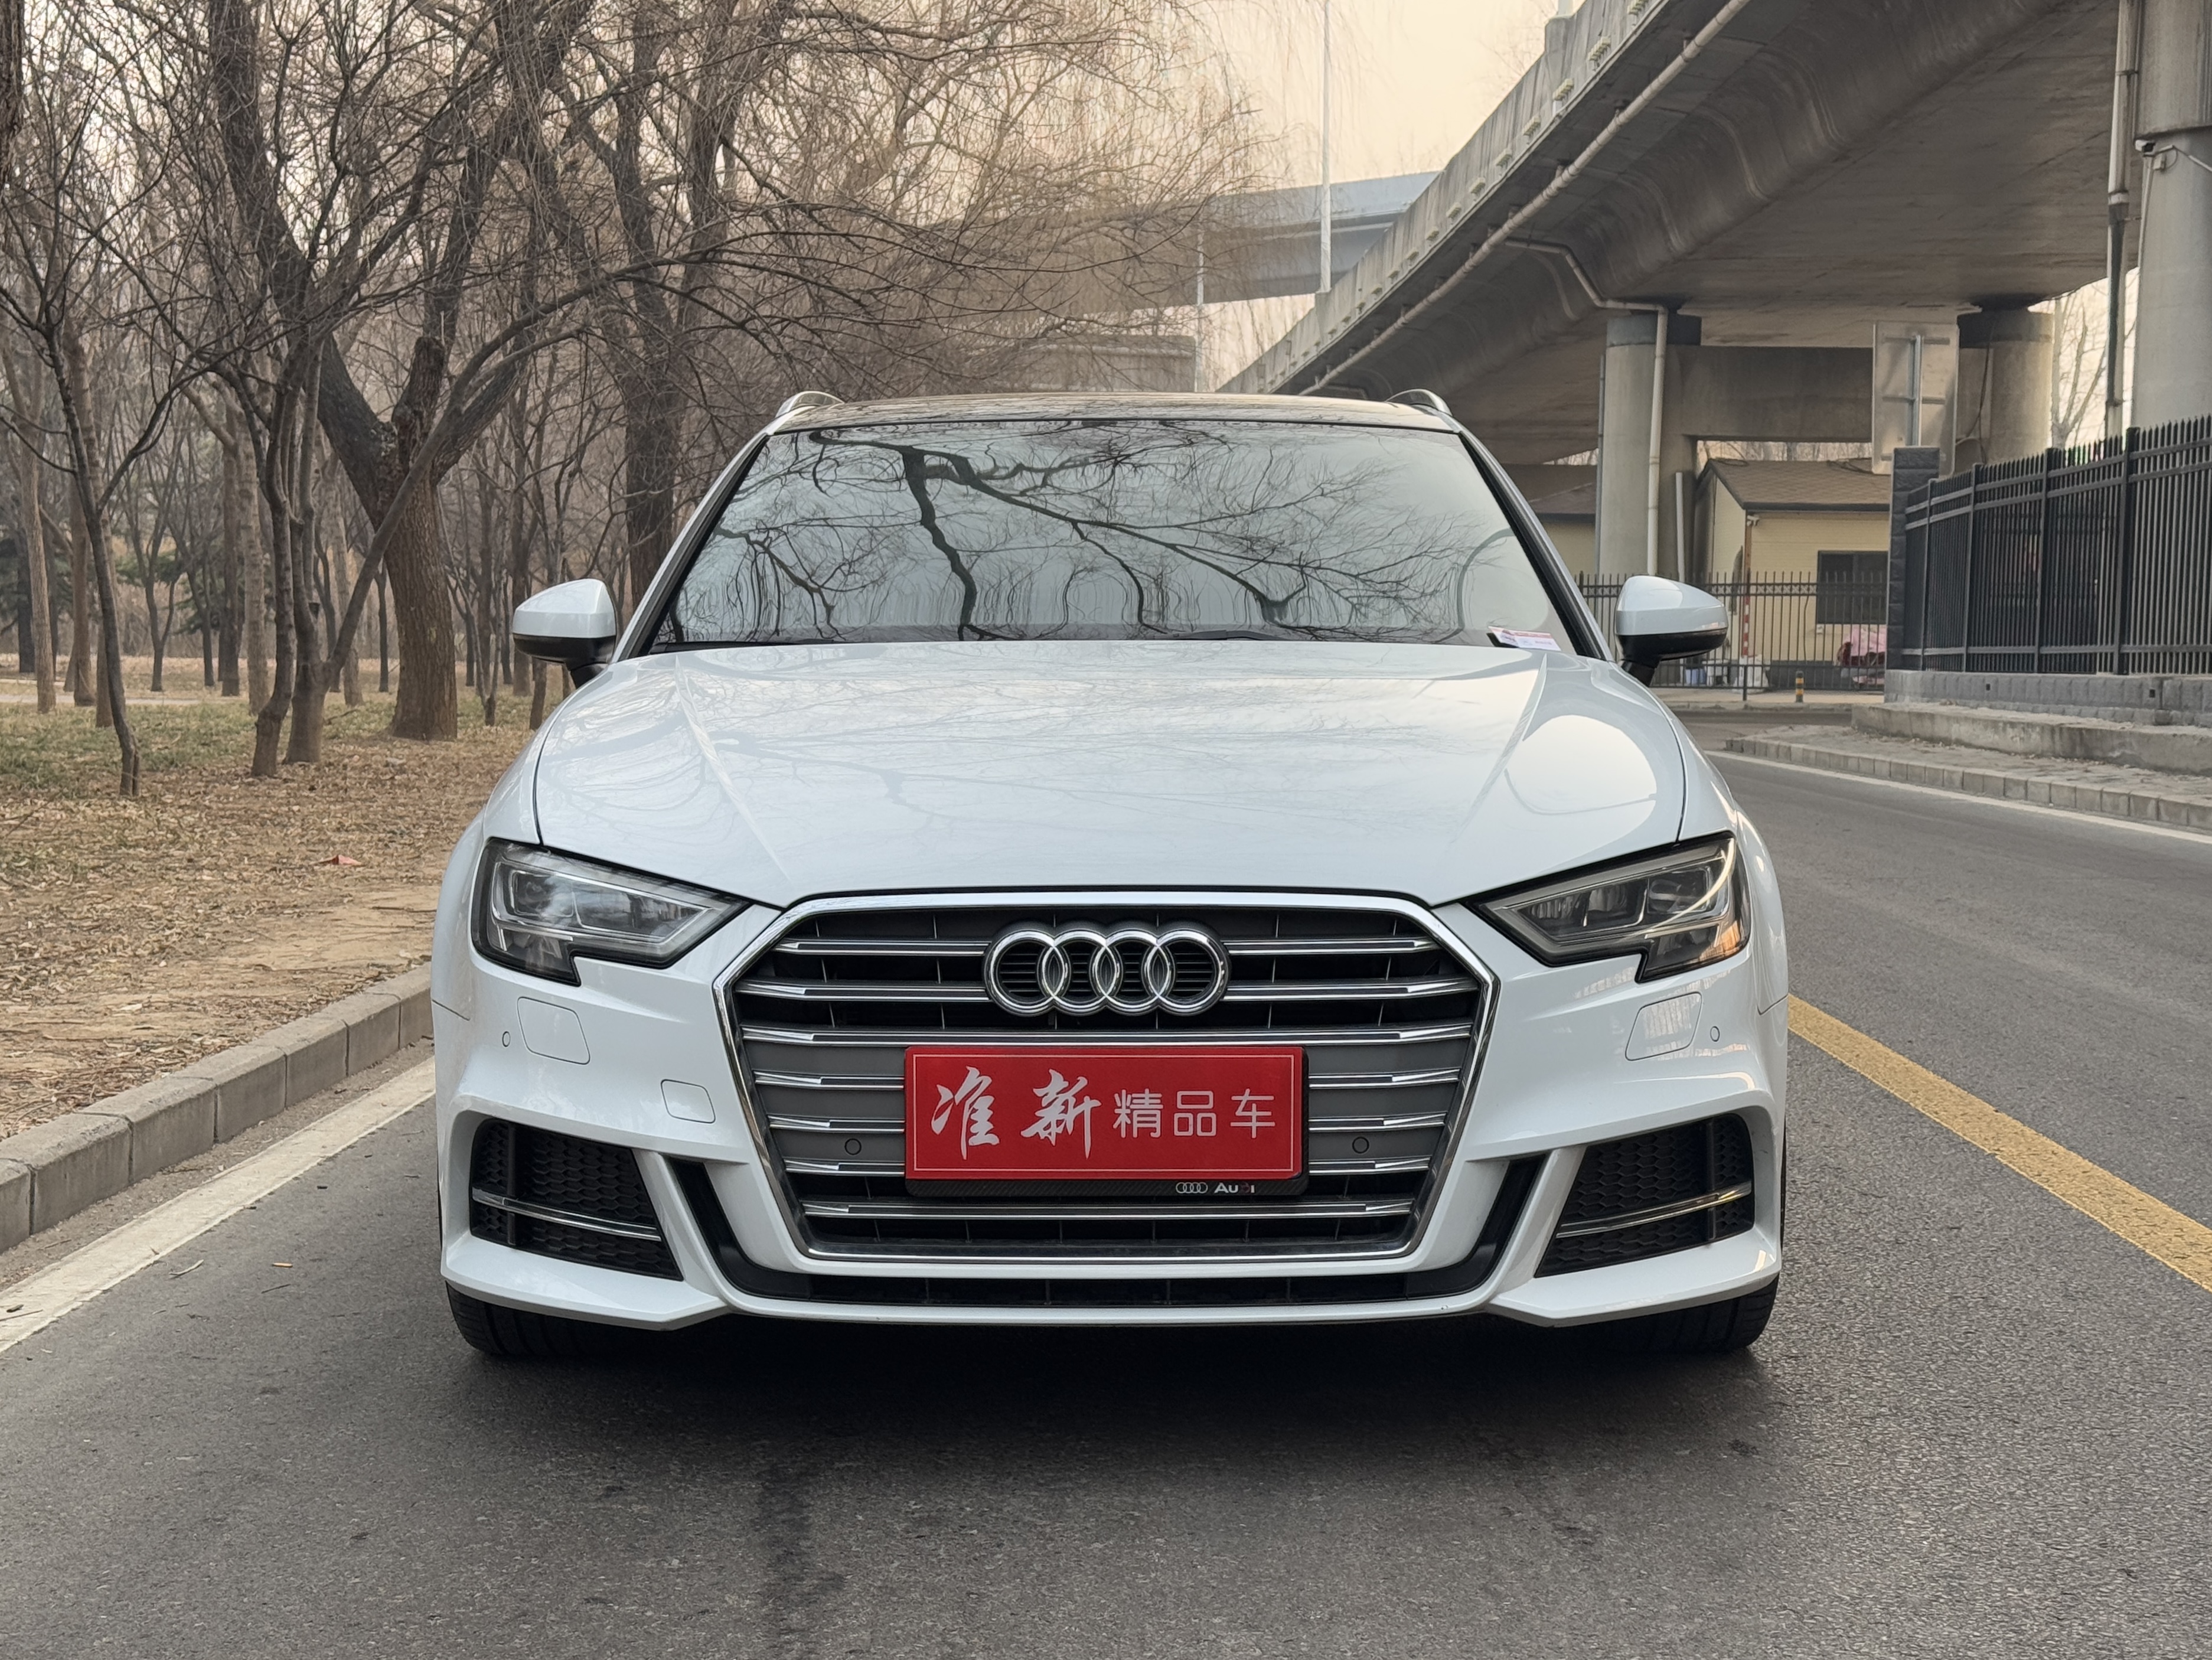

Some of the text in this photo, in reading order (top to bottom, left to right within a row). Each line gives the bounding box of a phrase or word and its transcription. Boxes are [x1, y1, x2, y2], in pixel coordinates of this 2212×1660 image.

[931, 1065, 1276, 1160] 准新精品车
[1214, 1182, 1255, 1193] Aui
